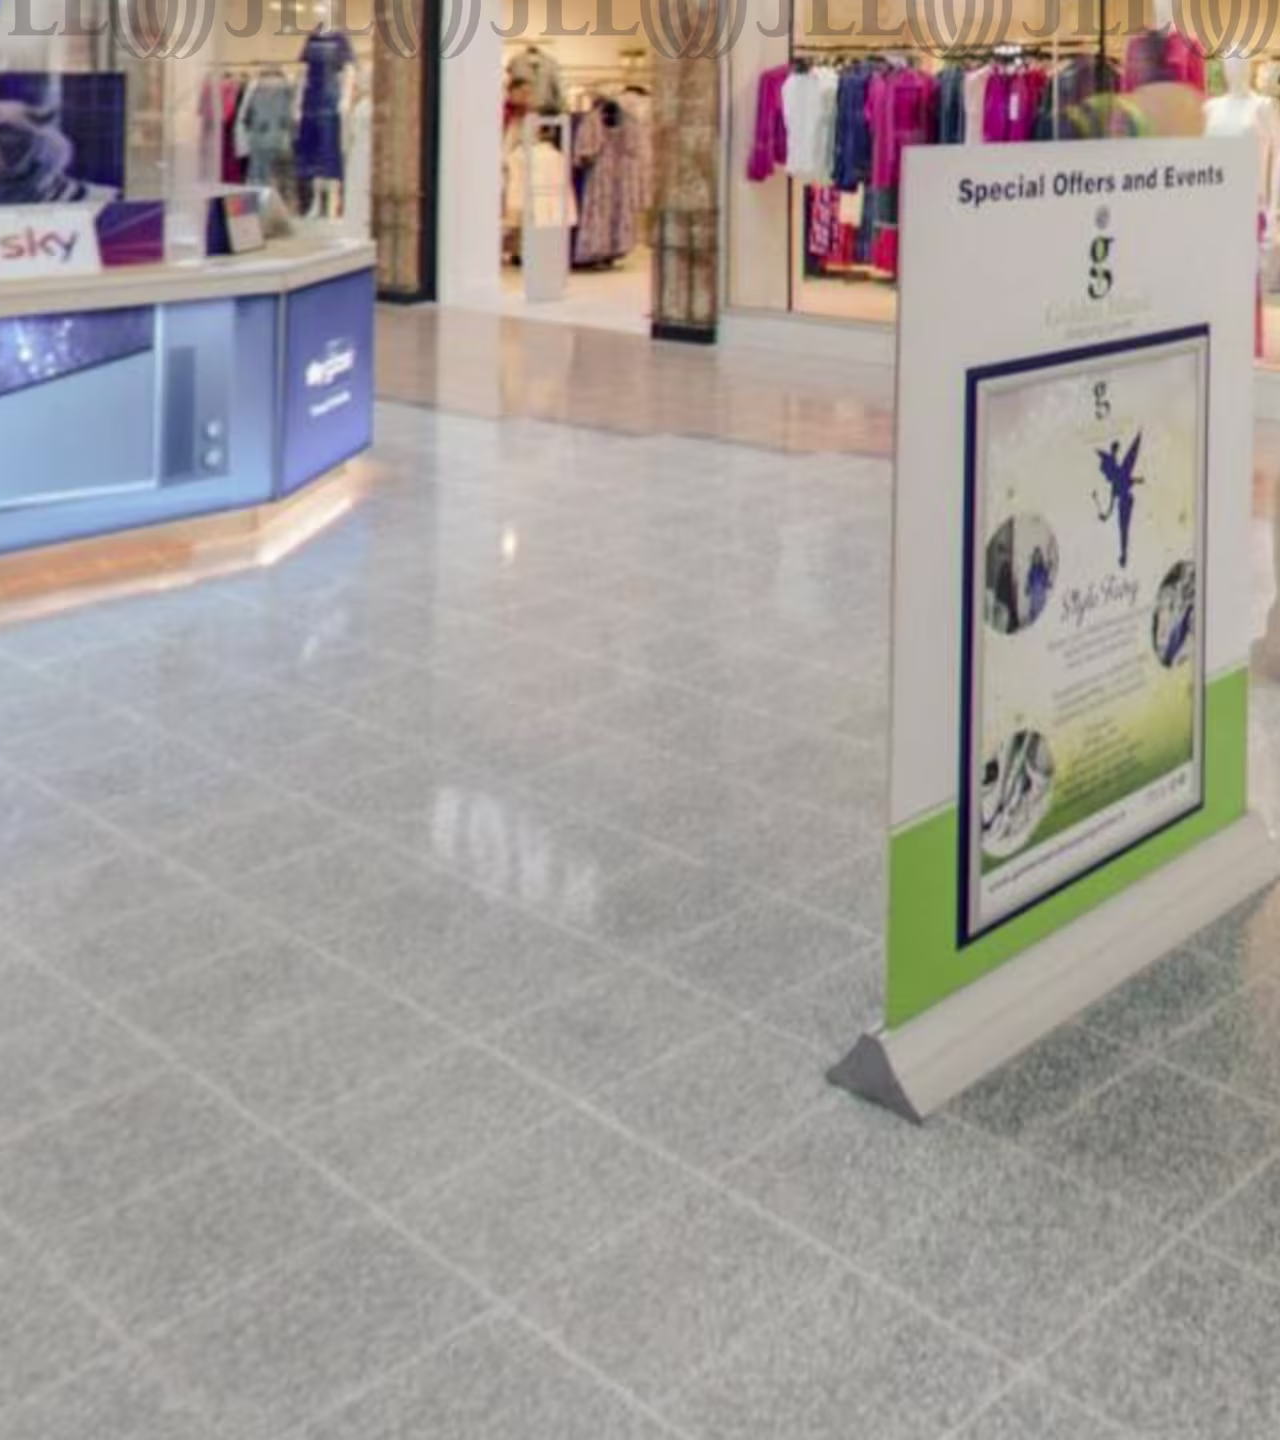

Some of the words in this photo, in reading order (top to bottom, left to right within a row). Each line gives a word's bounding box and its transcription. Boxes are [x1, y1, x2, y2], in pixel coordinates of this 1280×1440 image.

[958, 175, 1045, 208] Special
[1053, 172, 1116, 196] Offers
[1122, 170, 1158, 193] and
[1164, 164, 1225, 189] Events
[0, 227, 77, 262] sky
